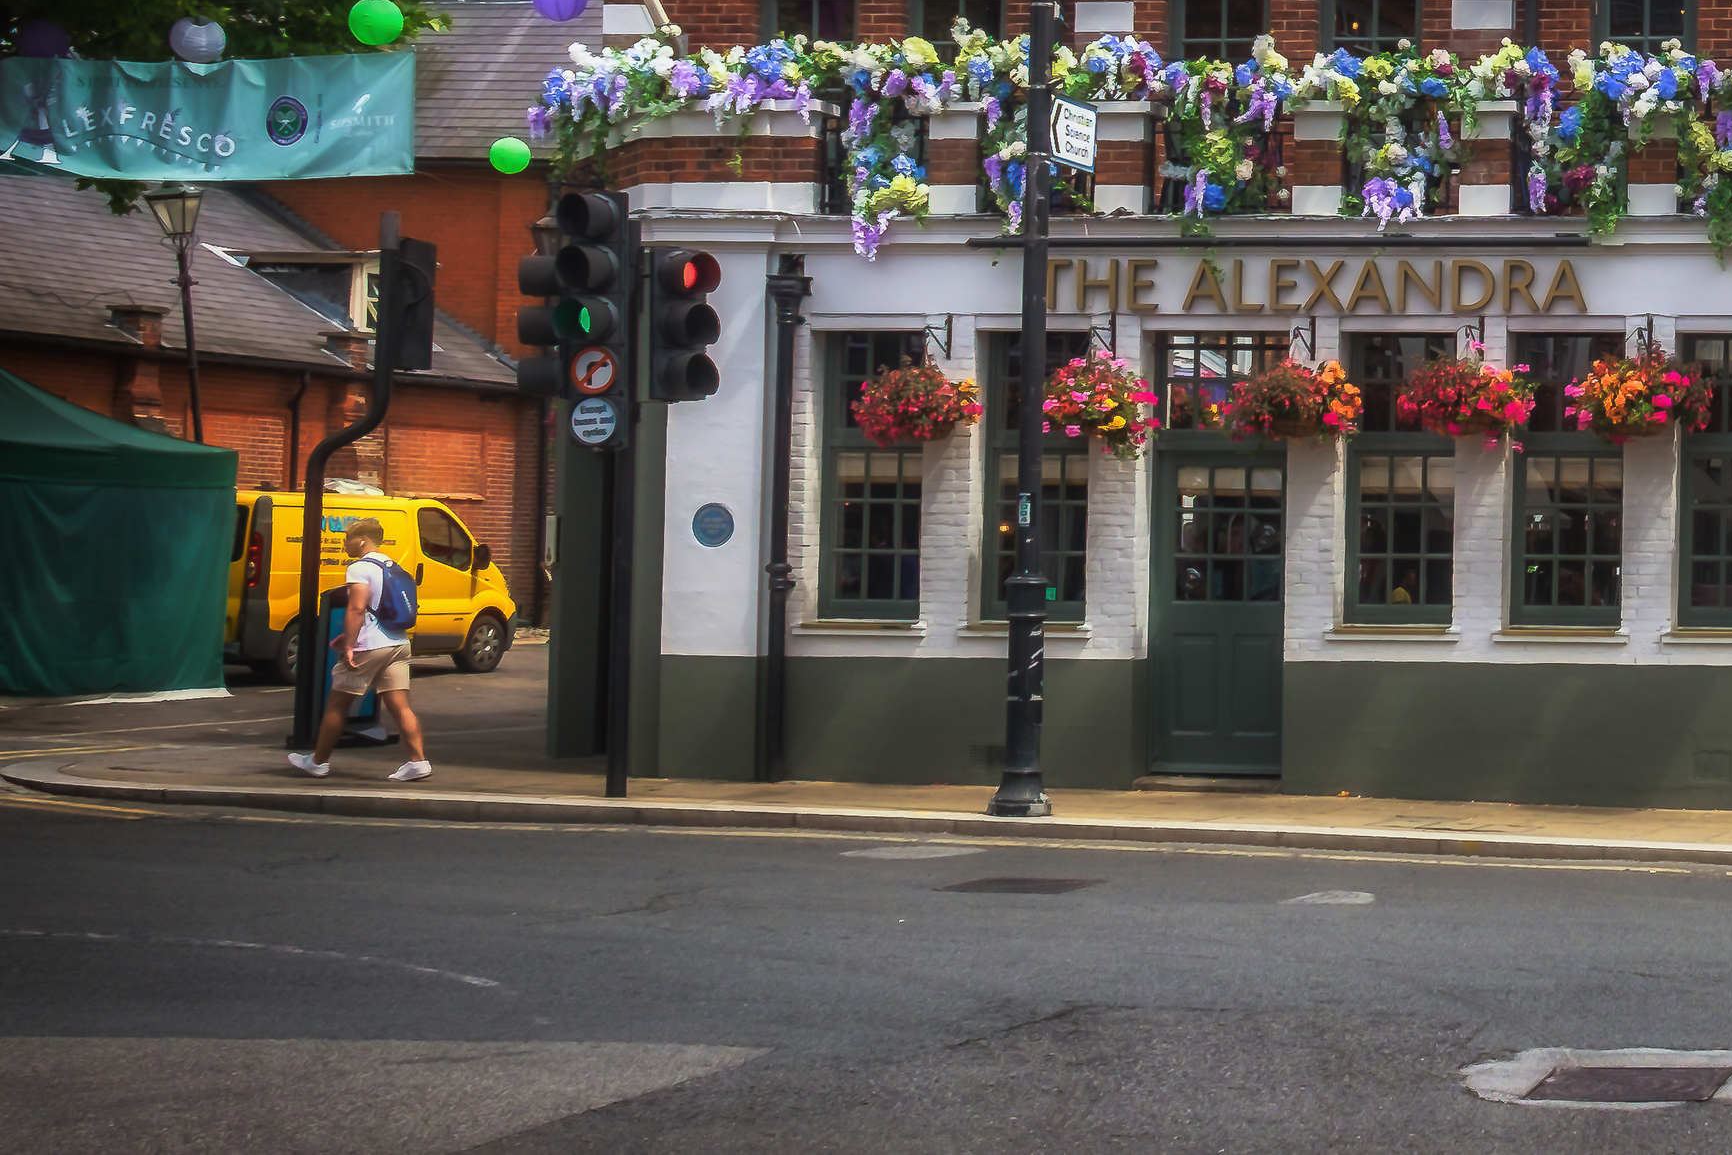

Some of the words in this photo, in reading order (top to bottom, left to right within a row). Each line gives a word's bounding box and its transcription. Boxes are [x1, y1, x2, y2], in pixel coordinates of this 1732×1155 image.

[329, 114, 396, 130] SIPSMITH
[1063, 107, 1093, 127] Christian
[1065, 124, 1091, 143] Science
[1065, 140, 1089, 158] Church
[1047, 258, 1159, 312] THE
[1182, 257, 1588, 312] ALEXANDRA
